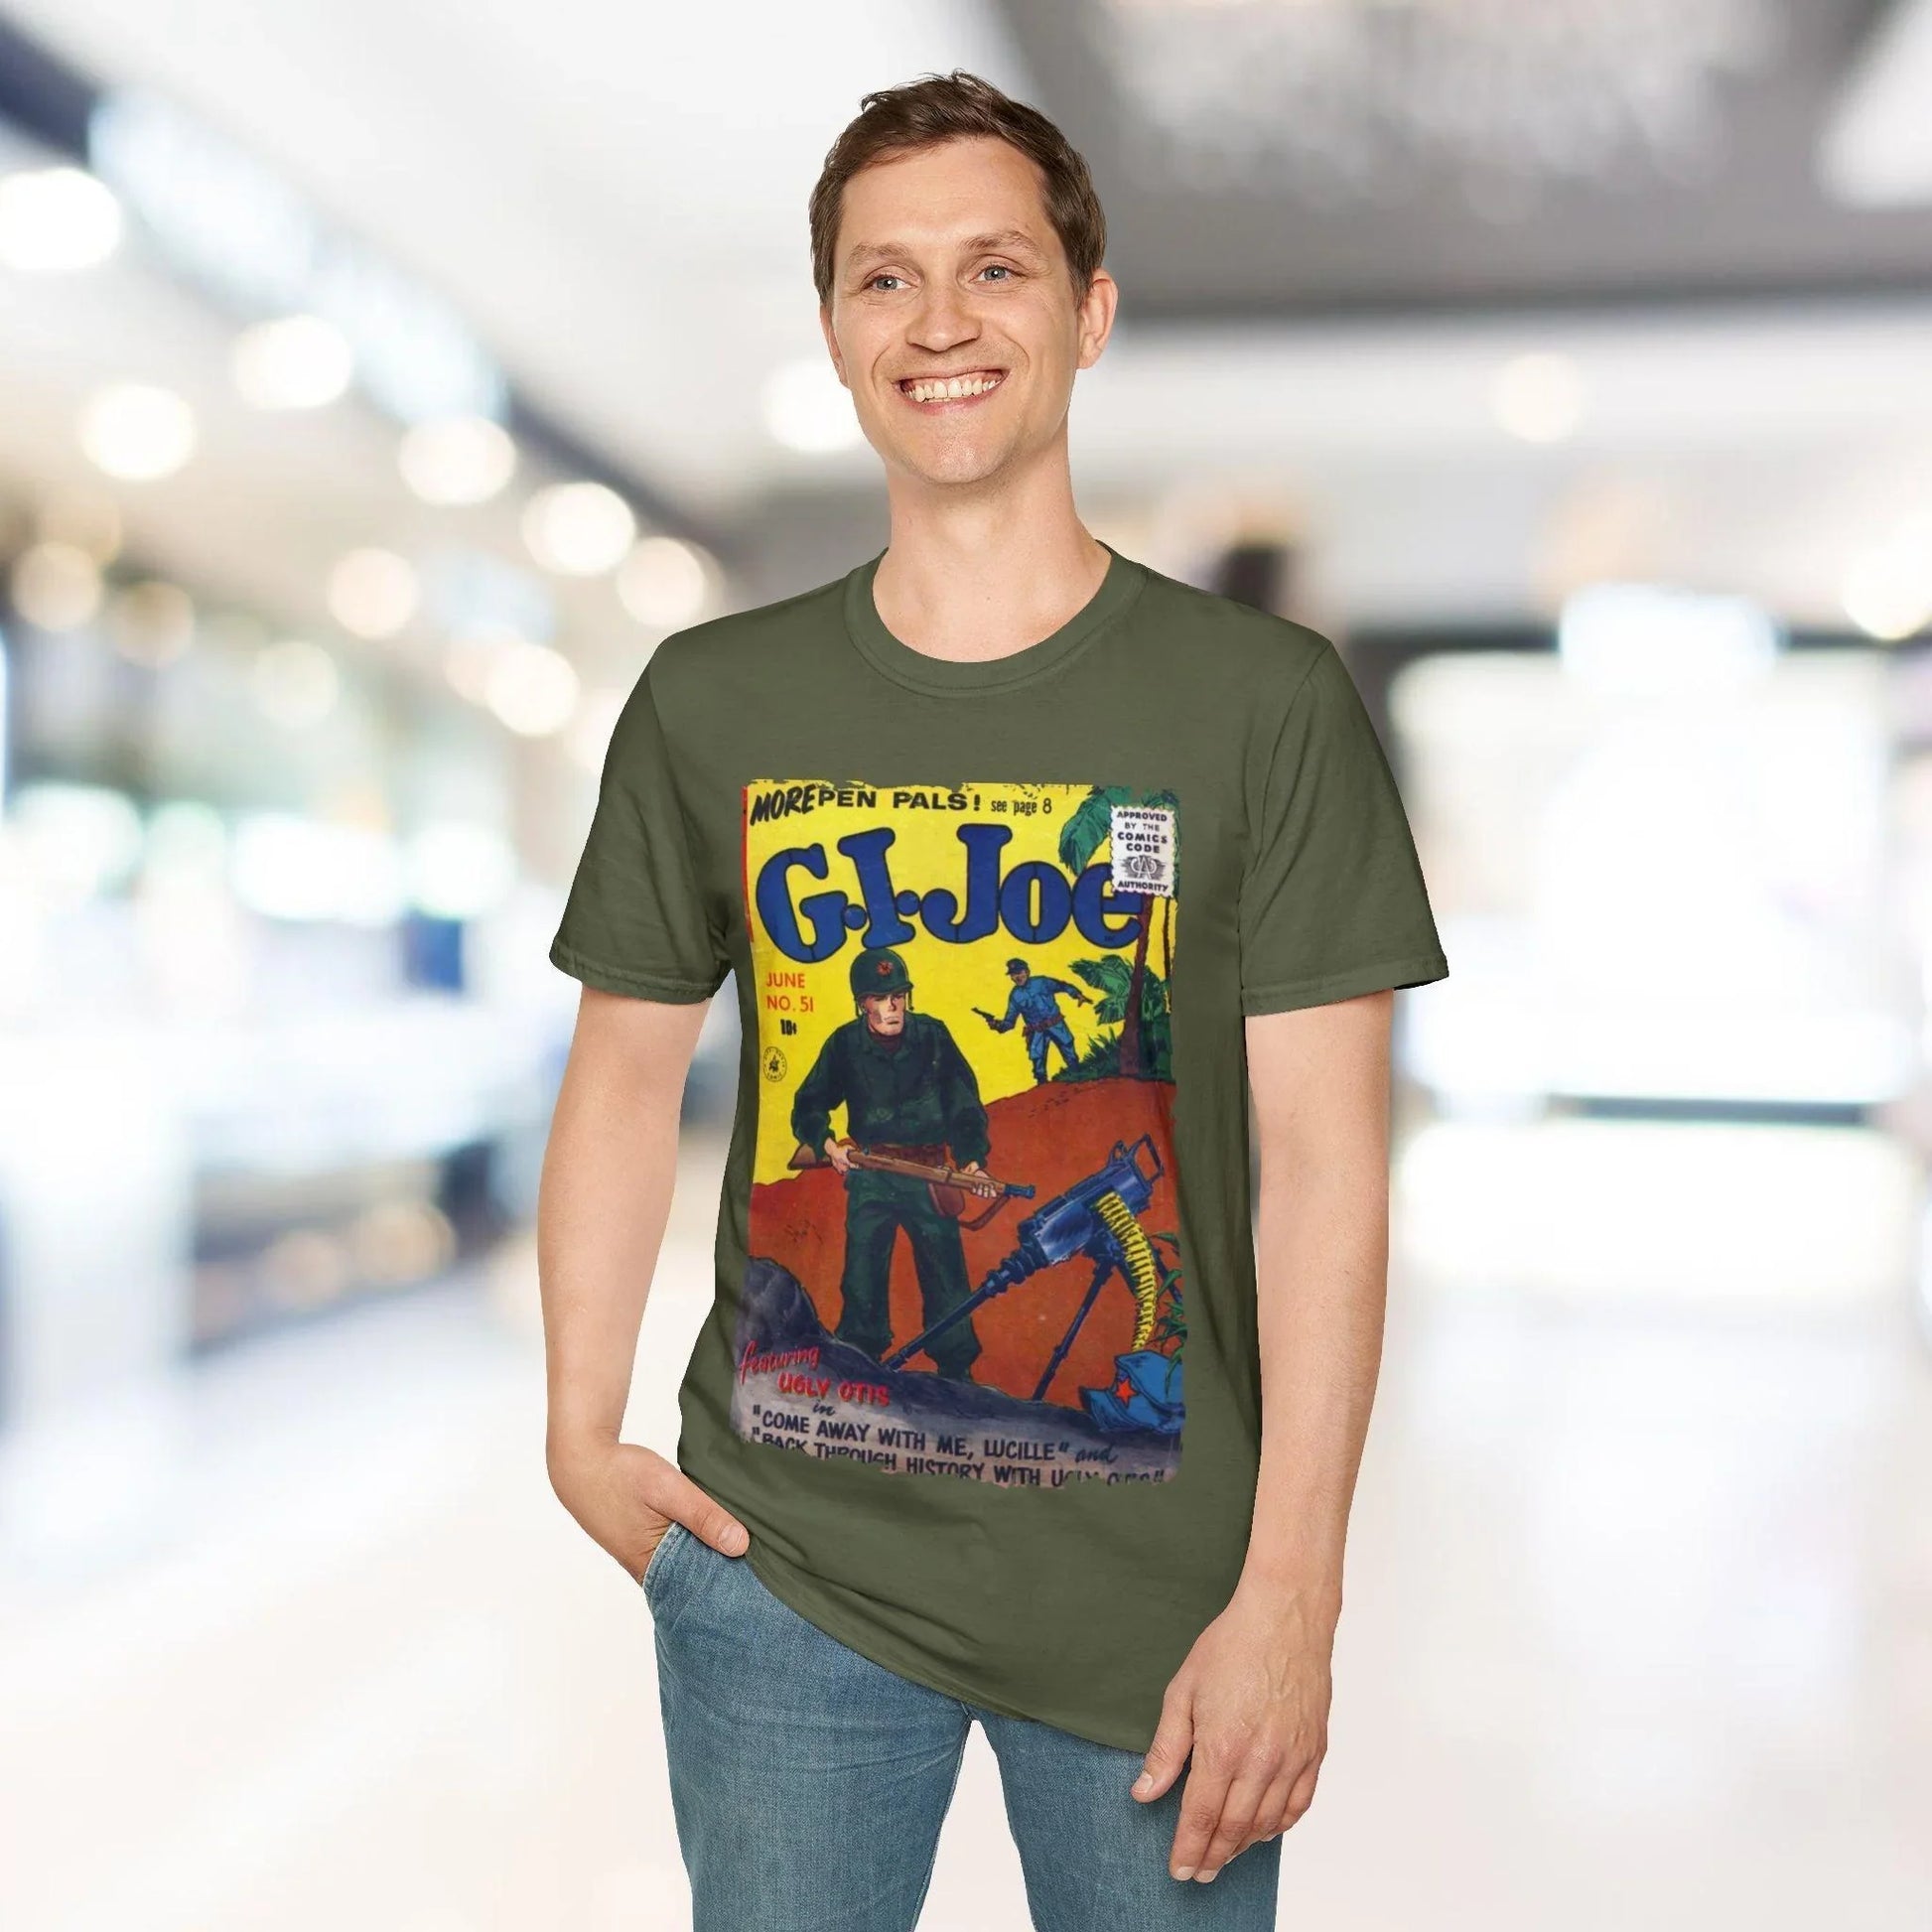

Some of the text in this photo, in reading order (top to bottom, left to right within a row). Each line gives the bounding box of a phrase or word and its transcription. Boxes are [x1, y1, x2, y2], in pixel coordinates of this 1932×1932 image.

[750, 784, 816, 826] MORE
[818, 789, 876, 808] PEN
[991, 799, 1008, 812] see
[1013, 800, 1037, 816] page
[1042, 797, 1052, 814] 8
[1117, 810, 1168, 822] APPROVED
[1143, 823, 1160, 832] THE
[1117, 832, 1168, 844] COMICS
[1126, 843, 1160, 854] CODE
[1118, 880, 1169, 893] AUTHORITY
[765, 972, 806, 989] JUNE
[766, 995, 796, 1012] NO.
[740, 1340, 820, 1386] featuring
[777, 1372, 891, 1408] UGLY OTIS
[812, 1399, 836, 1417] in
[816, 1420, 871, 1443] AWAY
[878, 1428, 926, 1451] WITH
[936, 1435, 974, 1460] ME,
[1075, 1443, 1118, 1463] and
[905, 1456, 985, 1480] HISTORY
[994, 1464, 1041, 1486] WITH
